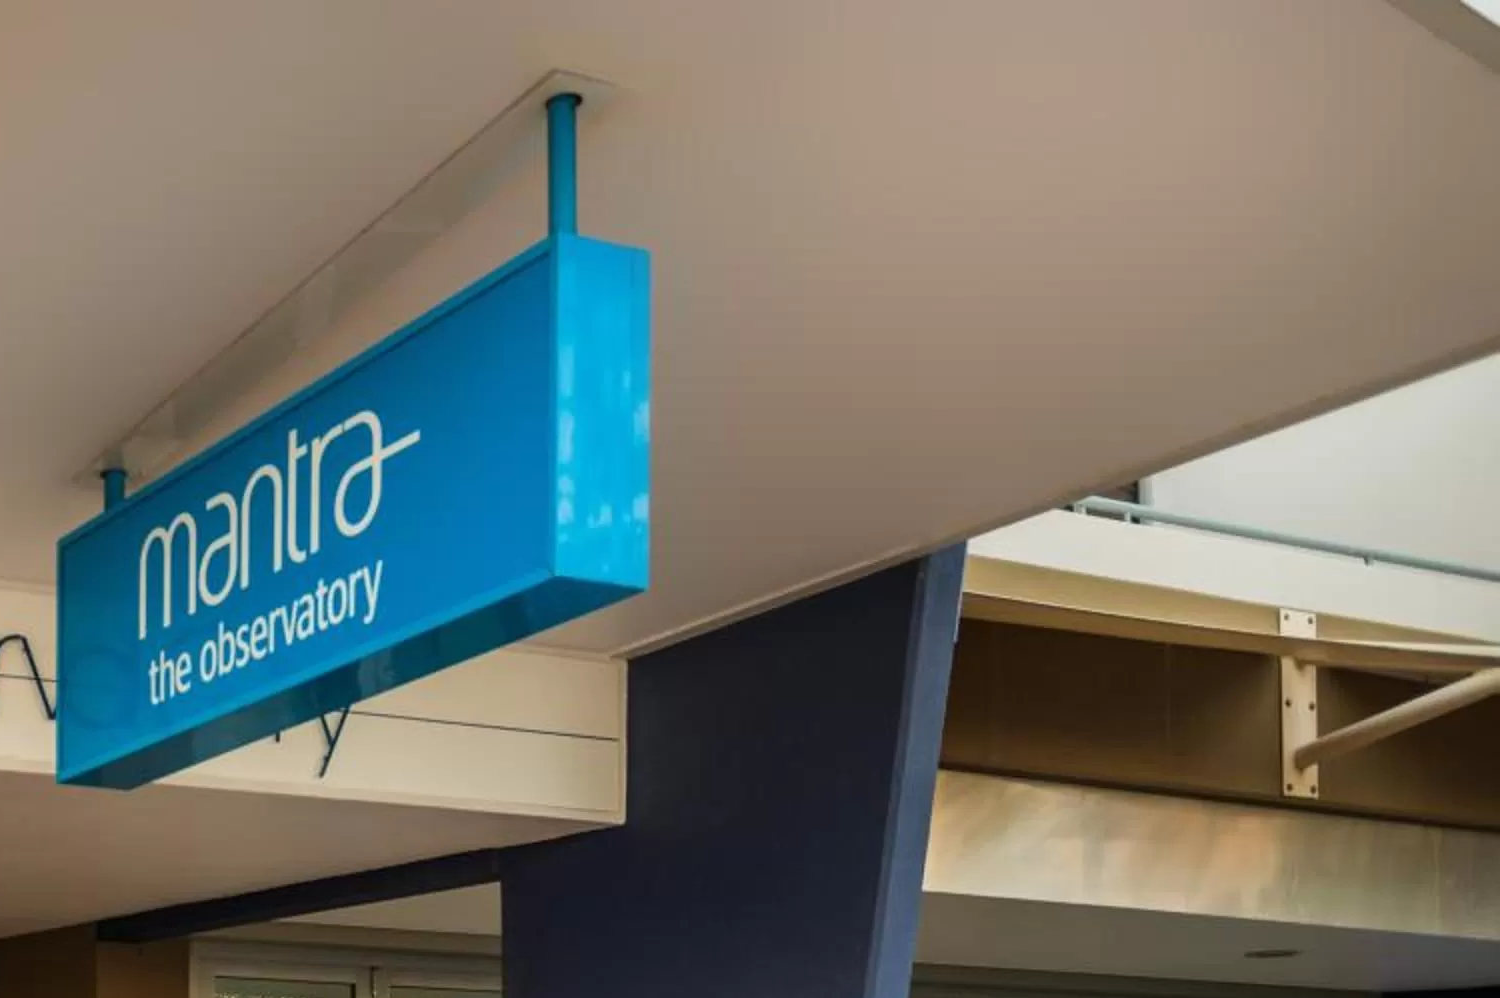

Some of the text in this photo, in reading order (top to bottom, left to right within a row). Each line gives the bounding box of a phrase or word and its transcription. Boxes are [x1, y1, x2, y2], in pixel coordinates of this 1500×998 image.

[137, 409, 422, 640] mantra
[148, 559, 383, 705] the observatory
